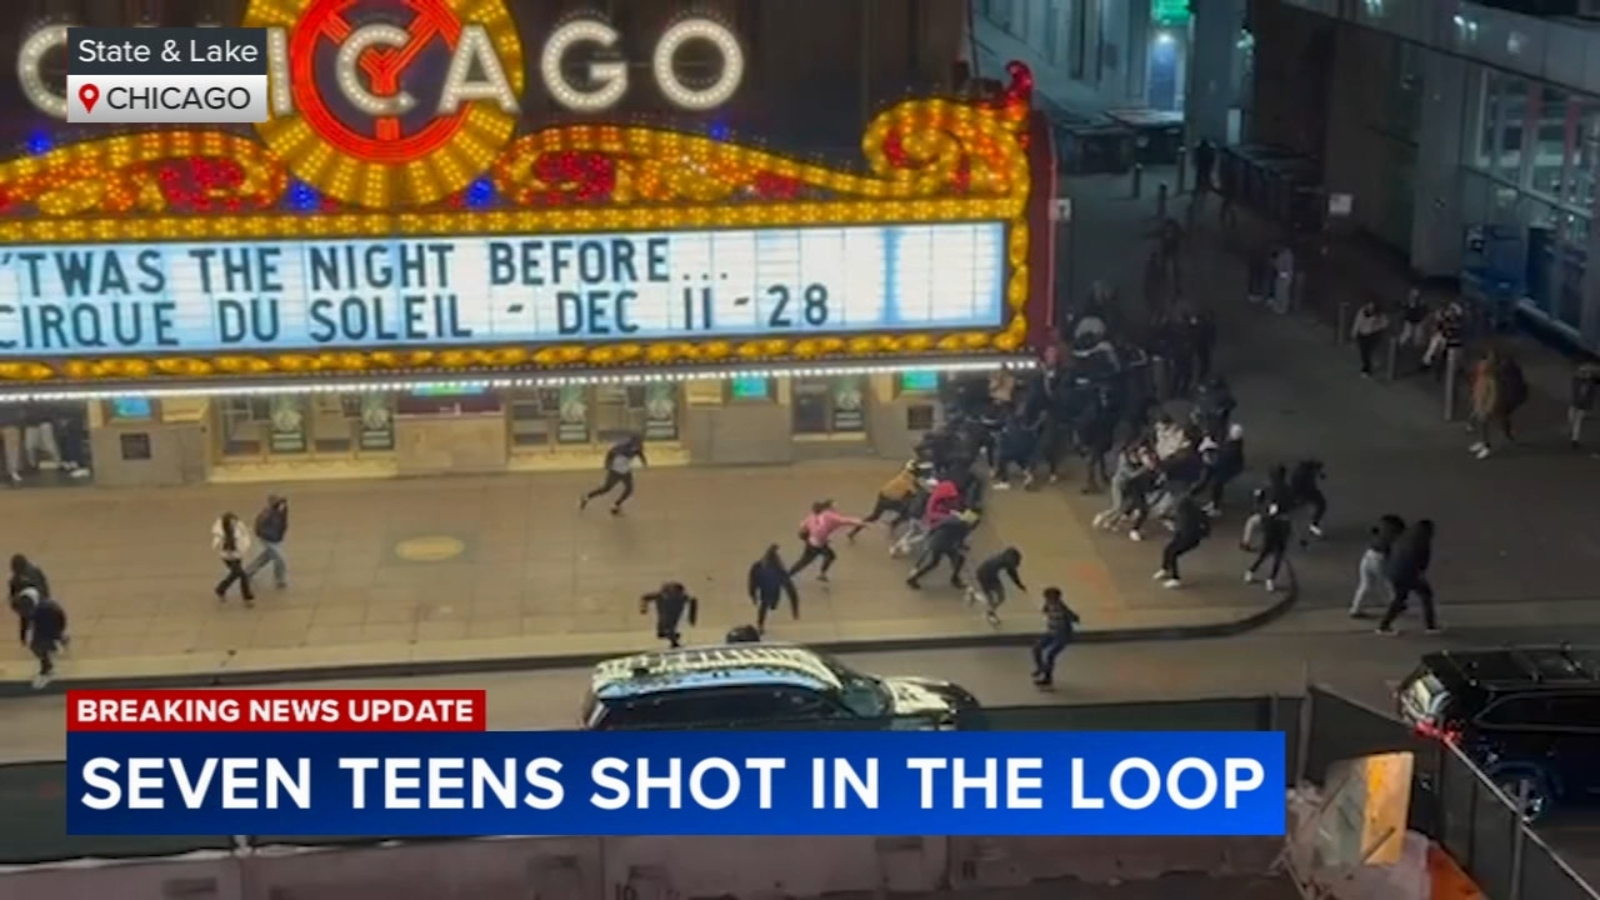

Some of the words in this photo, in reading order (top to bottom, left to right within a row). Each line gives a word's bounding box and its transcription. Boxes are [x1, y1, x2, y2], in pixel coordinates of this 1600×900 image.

[17, 19, 744, 119] CICAGO
[0, 249, 166, 297] 'TWAS
[188, 247, 283, 294] THE
[309, 243, 455, 291] NIGHT
[217, 299, 280, 343] DU
[309, 295, 472, 342] SOLEIL
[556, 290, 639, 335] DEC
